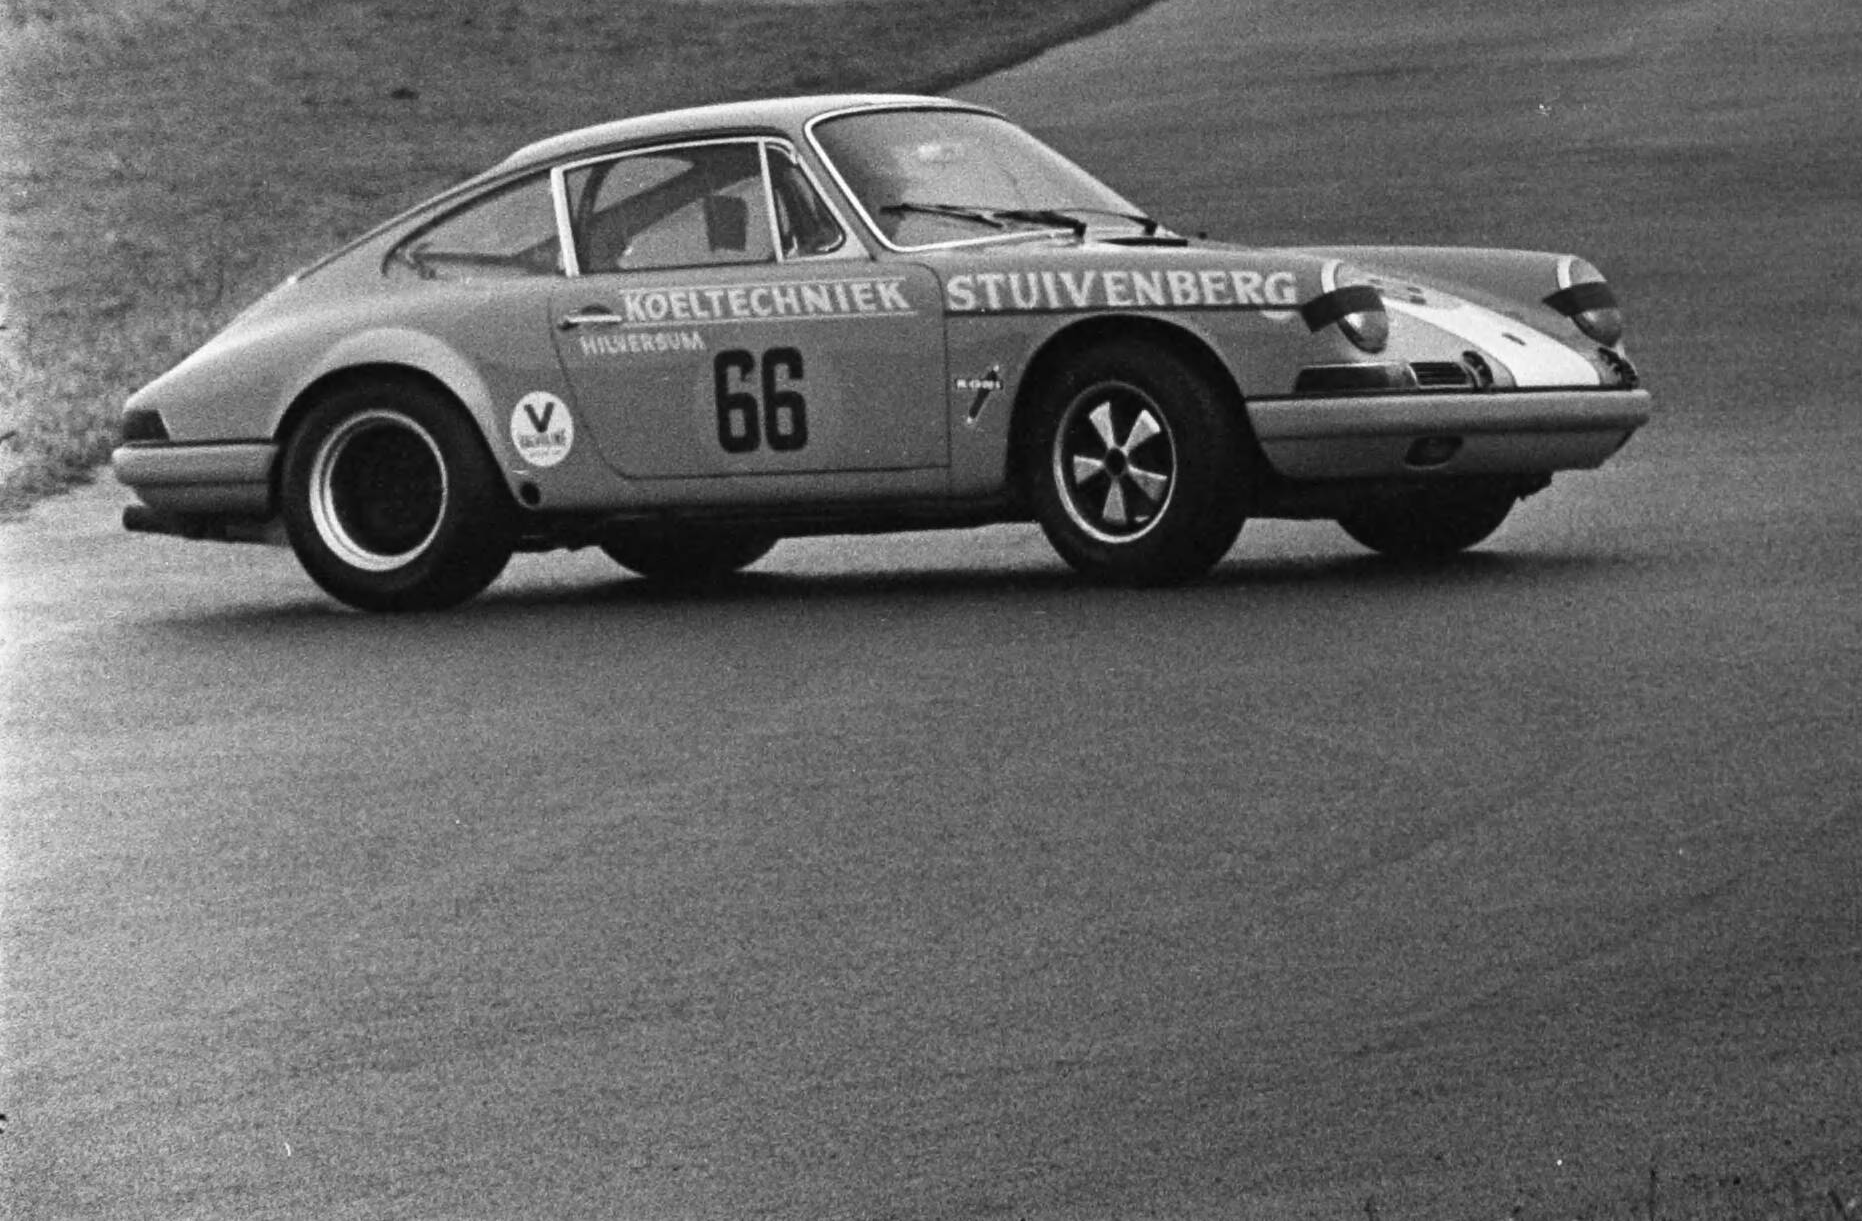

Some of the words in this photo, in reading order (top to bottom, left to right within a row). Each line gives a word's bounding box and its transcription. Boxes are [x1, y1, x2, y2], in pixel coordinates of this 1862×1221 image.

[622, 280, 910, 322] KOELTECHNIEK
[946, 269, 1298, 311] STUIVENBERG
[580, 330, 706, 356] HILVERSUM
[523, 401, 555, 433] V
[714, 347, 809, 454] 66
